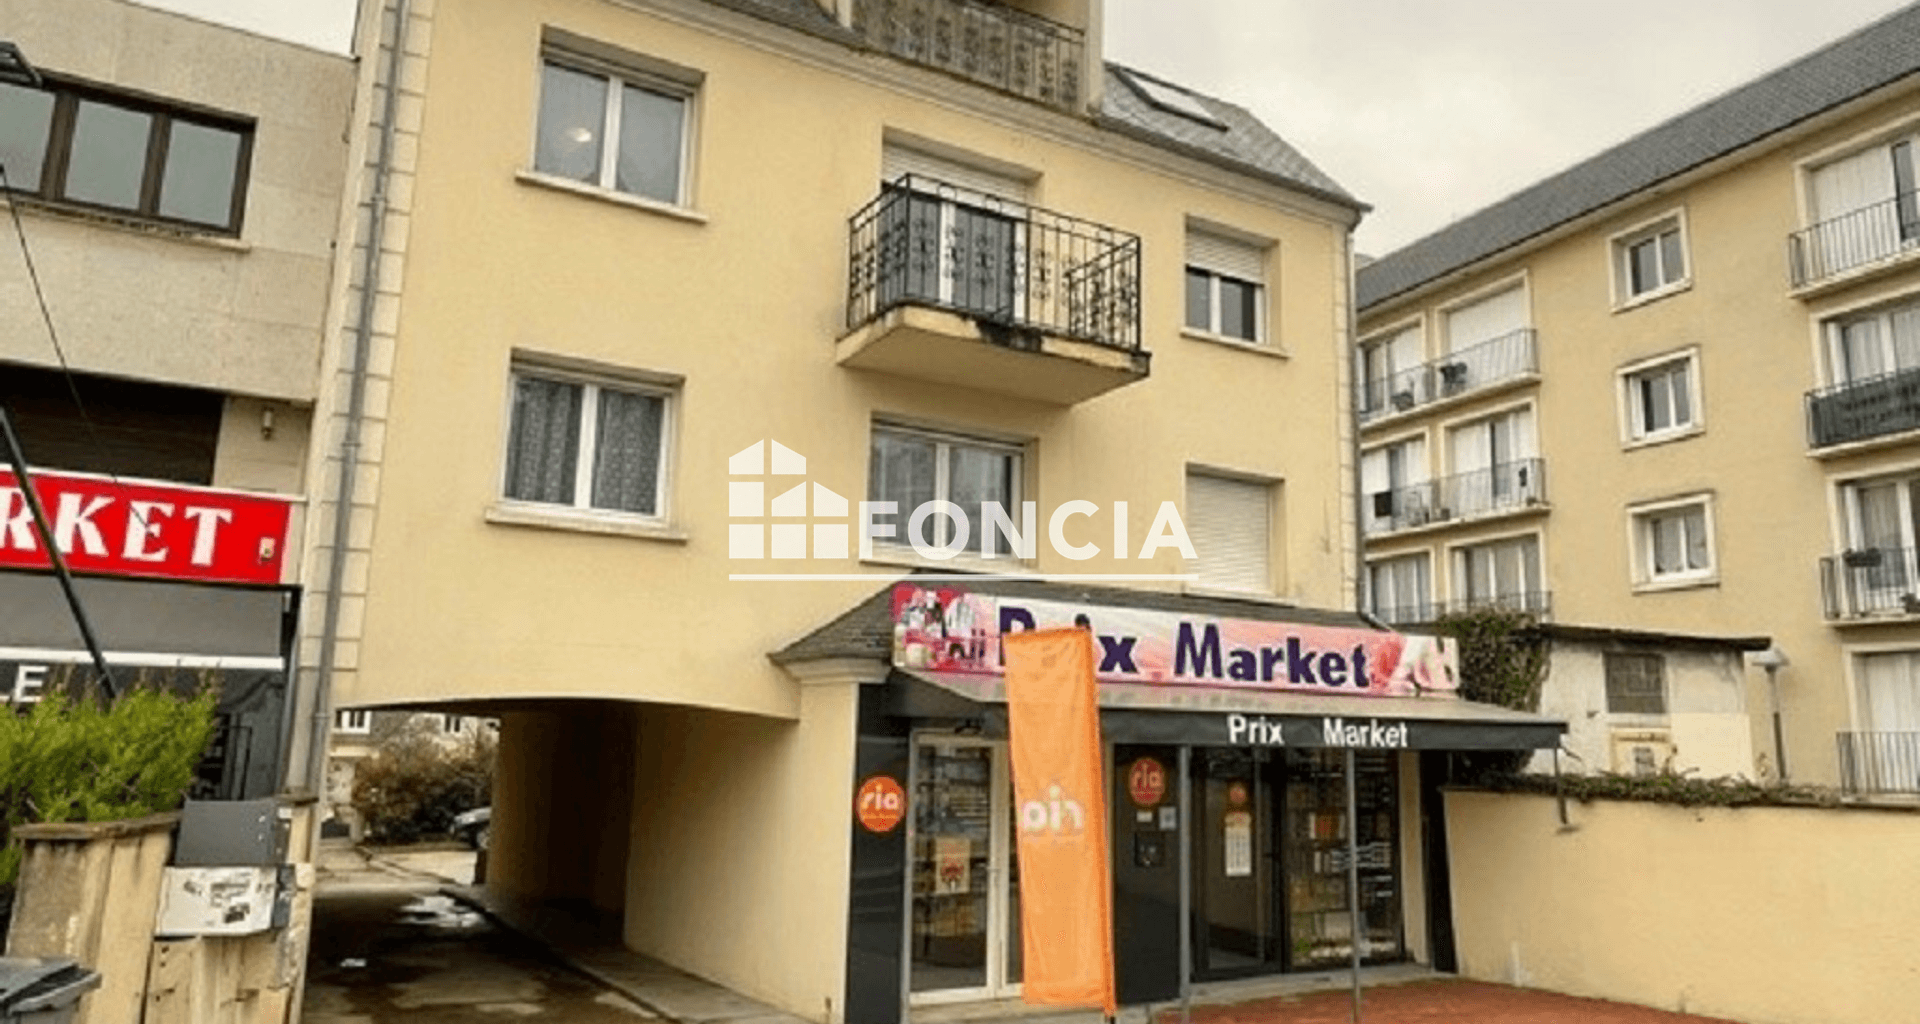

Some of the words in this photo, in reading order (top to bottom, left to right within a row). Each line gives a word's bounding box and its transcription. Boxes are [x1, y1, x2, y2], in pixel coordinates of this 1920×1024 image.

[0, 486, 233, 567] RKET
[1173, 621, 1371, 689] Market
[1228, 714, 1285, 746] Prix
[1322, 717, 1408, 749] Market
[861, 783, 900, 811] ria
